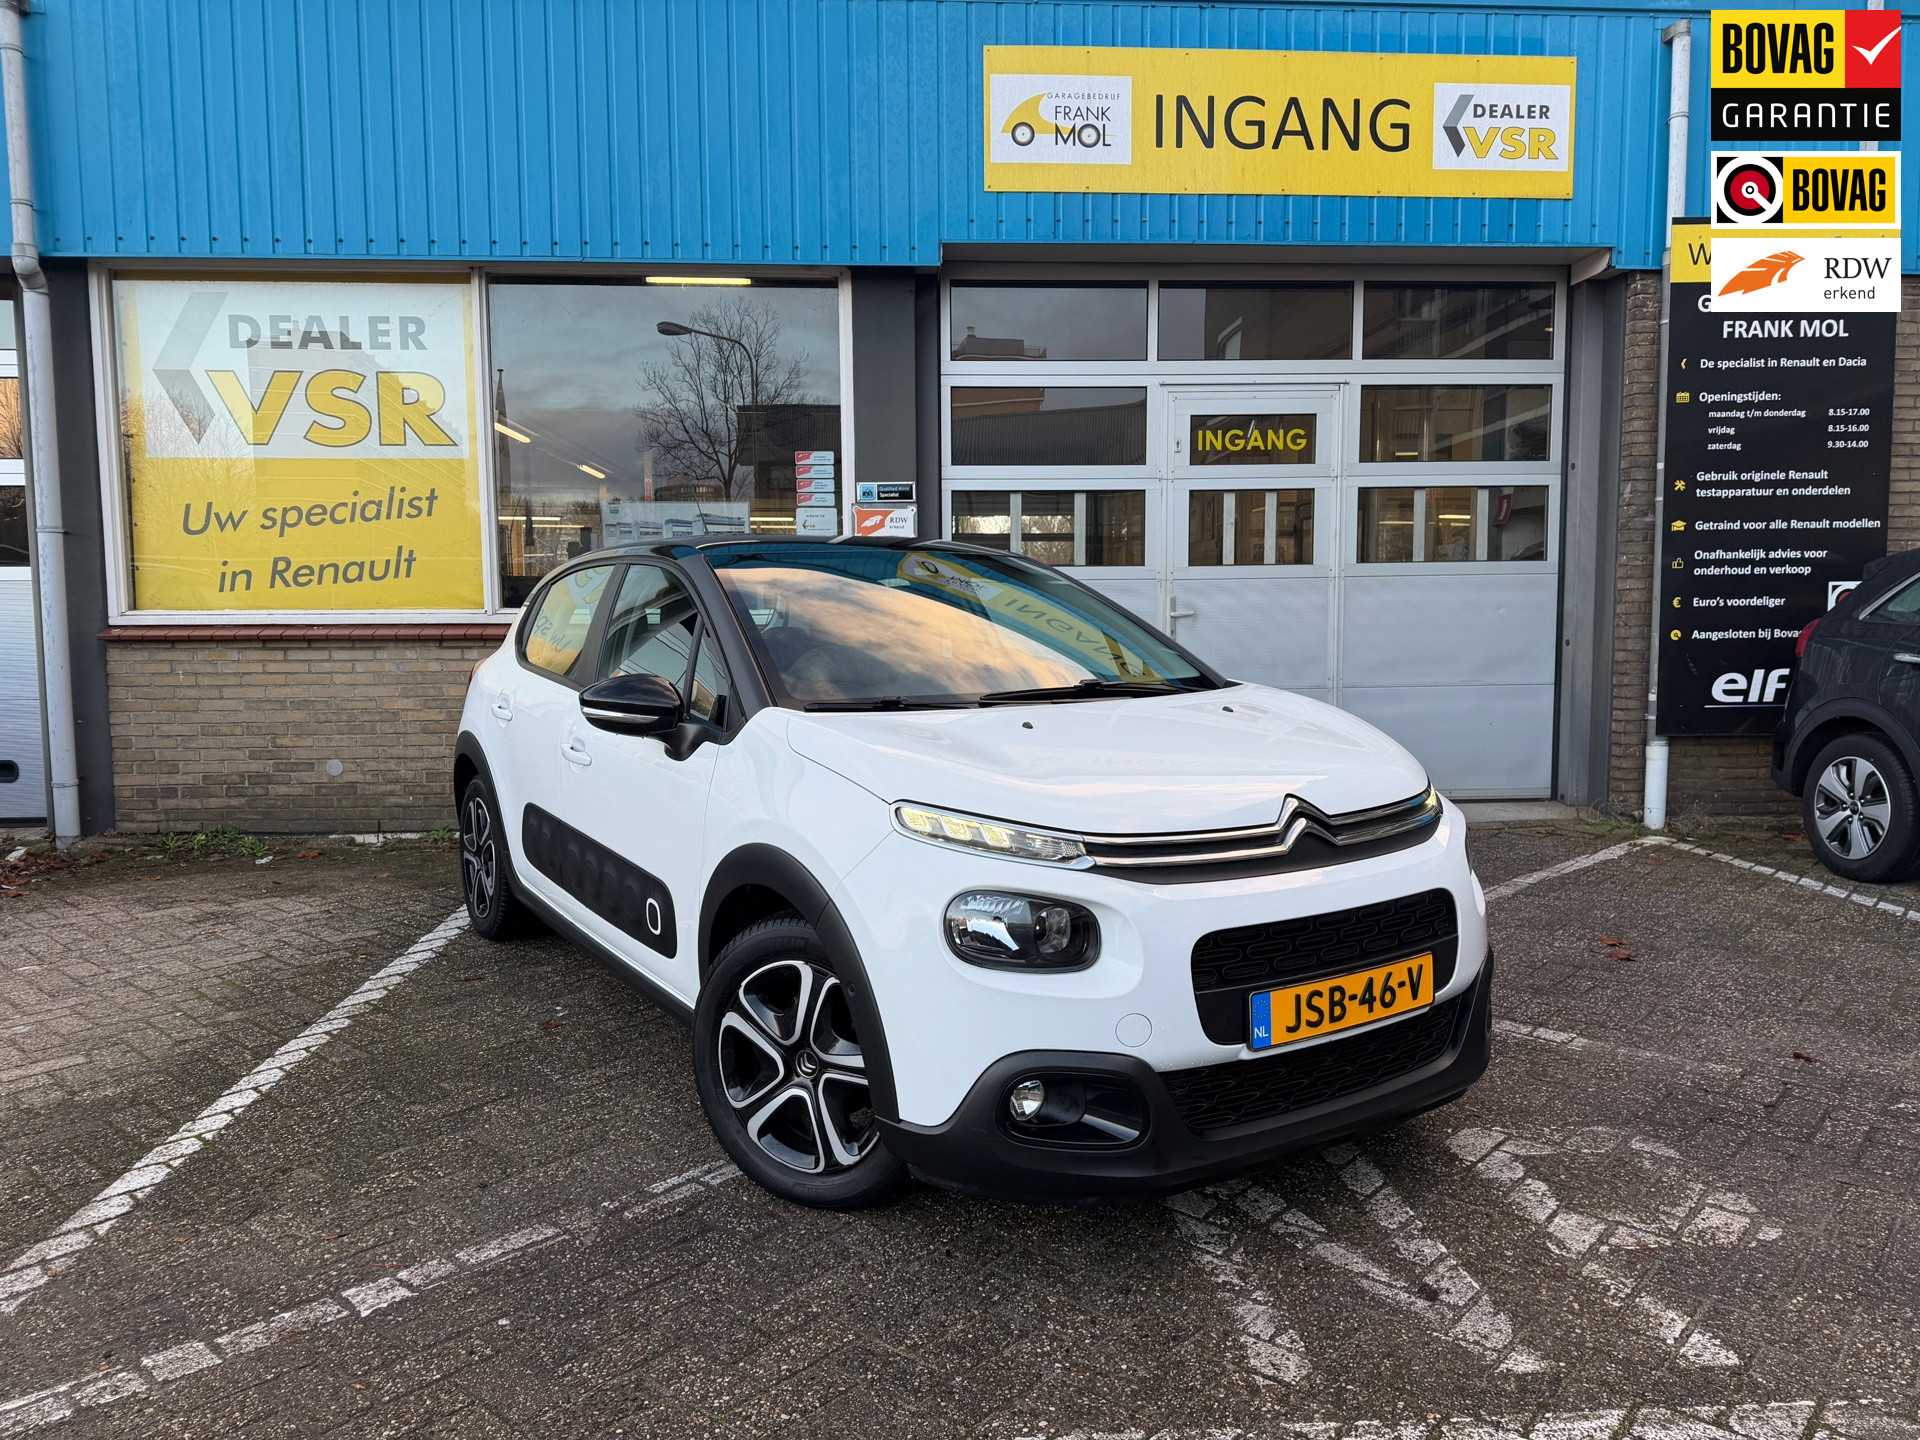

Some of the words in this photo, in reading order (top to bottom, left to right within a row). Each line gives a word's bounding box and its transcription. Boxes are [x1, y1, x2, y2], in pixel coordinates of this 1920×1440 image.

[1054, 105, 1111, 122] FRANK
[1473, 103, 1550, 120] DEALER
[1155, 93, 1411, 153] INGANG
[1054, 122, 1112, 149] MOL
[1462, 126, 1559, 160] VSR
[227, 314, 428, 351] DEALER
[1722, 320, 1794, 339] FRANK
[1800, 319, 1849, 338] MOL
[1700, 358, 1715, 369] De
[1717, 357, 1765, 370] specialist
[1767, 357, 1778, 368] in
[1780, 356, 1820, 367] Renault
[1822, 359, 1836, 367] en
[1838, 356, 1867, 367] Dacia
[1699, 390, 1782, 404] Openingstijden:
[204, 369, 459, 447] VSR
[1708, 409, 1745, 419] maandag
[1746, 408, 1762, 418] t/m
[1763, 408, 1806, 418] donderdag
[1828, 407, 1870, 416] 8.15-17.00
[1708, 425, 1735, 435] vrijdag
[1827, 424, 1870, 432] 8.15-16.00
[1197, 428, 1307, 451] INGANG
[1707, 441, 1742, 451] zaterdag
[1827, 440, 1869, 448] 9.30-14.00
[1696, 471, 1739, 481] Gebruik
[1740, 470, 1786, 482] originele
[1788, 469, 1829, 480] Renault
[1696, 487, 1774, 499] testapparatuur
[1776, 488, 1789, 496] en
[1791, 485, 1851, 496] onderdelen
[181, 501, 248, 536] Uw
[259, 486, 438, 538] specialist
[1695, 520, 1741, 530] Getraind
[1743, 521, 1767, 529] voor
[1769, 519, 1788, 529] alle
[1790, 518, 1830, 528] Renault
[1832, 518, 1881, 528] modellen
[1694, 549, 1766, 561] Onafhankelijk
[1768, 548, 1802, 558] advies
[1803, 550, 1828, 558] voor
[218, 560, 253, 592] in
[269, 545, 416, 589] Renault
[1693, 565, 1751, 575] onderhoud
[1753, 566, 1767, 574] en
[1769, 564, 1812, 576] verkoop
[1693, 597, 1725, 607] Euro's
[1726, 596, 1786, 608] voordeliger
[1691, 629, 1756, 641] Aangesloten
[1758, 629, 1772, 640] bij
[1711, 668, 1791, 703] elf
[1285, 963, 1424, 1034] JSB-46-V
[1254, 1026, 1269, 1039] NL
